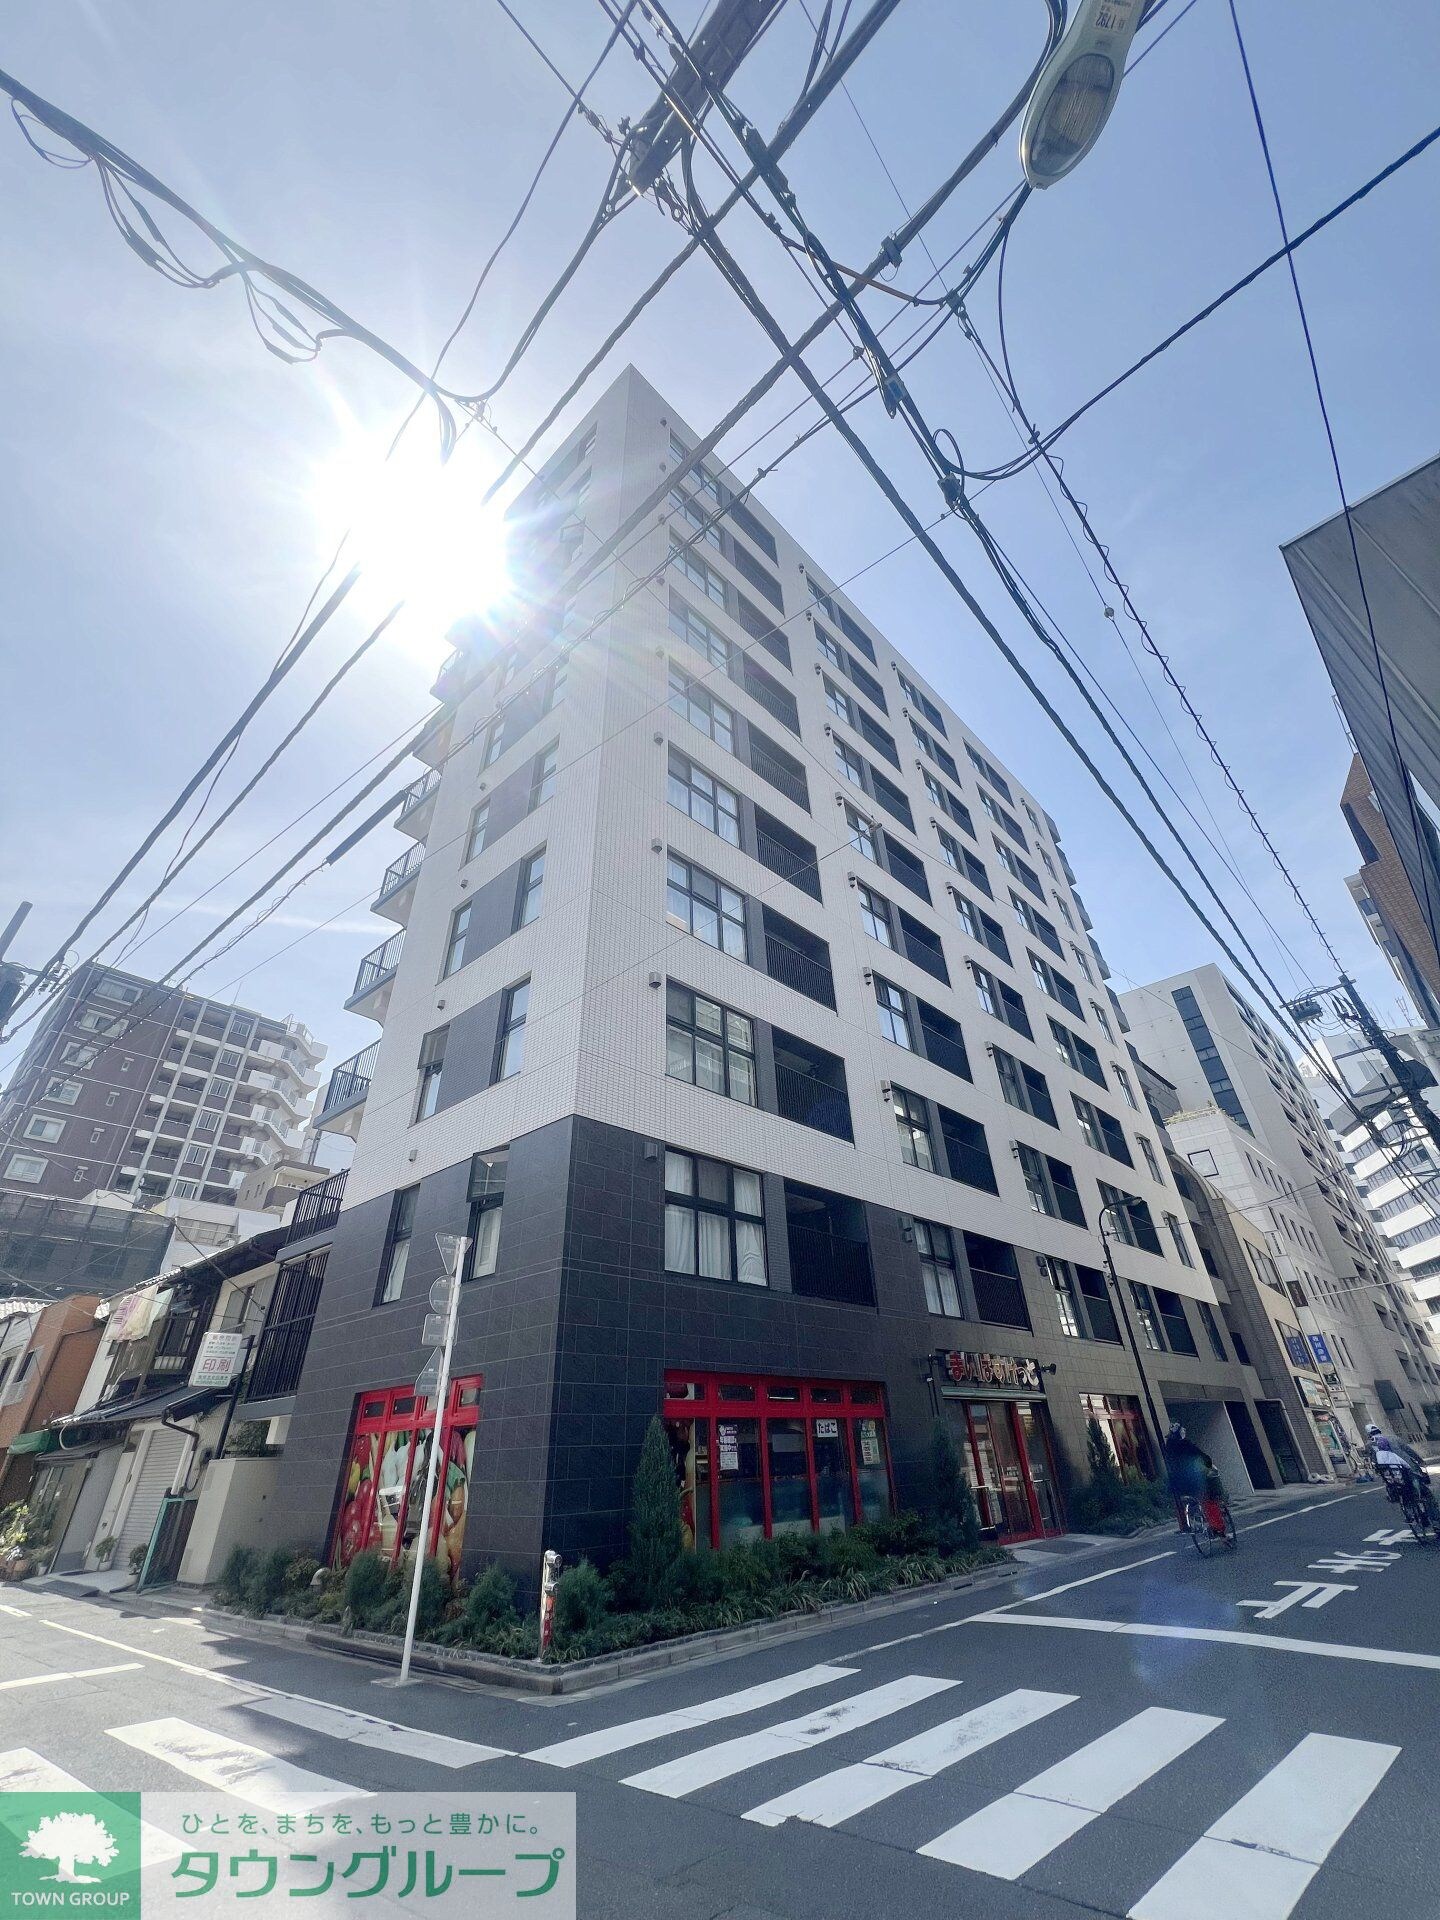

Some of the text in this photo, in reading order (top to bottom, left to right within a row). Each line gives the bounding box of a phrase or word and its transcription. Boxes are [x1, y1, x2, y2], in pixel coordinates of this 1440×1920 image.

[202, 1358, 232, 1372] 印刷
[948, 1351, 1040, 1387] まいばすけっと
[817, 1422, 837, 1434] たばこ
